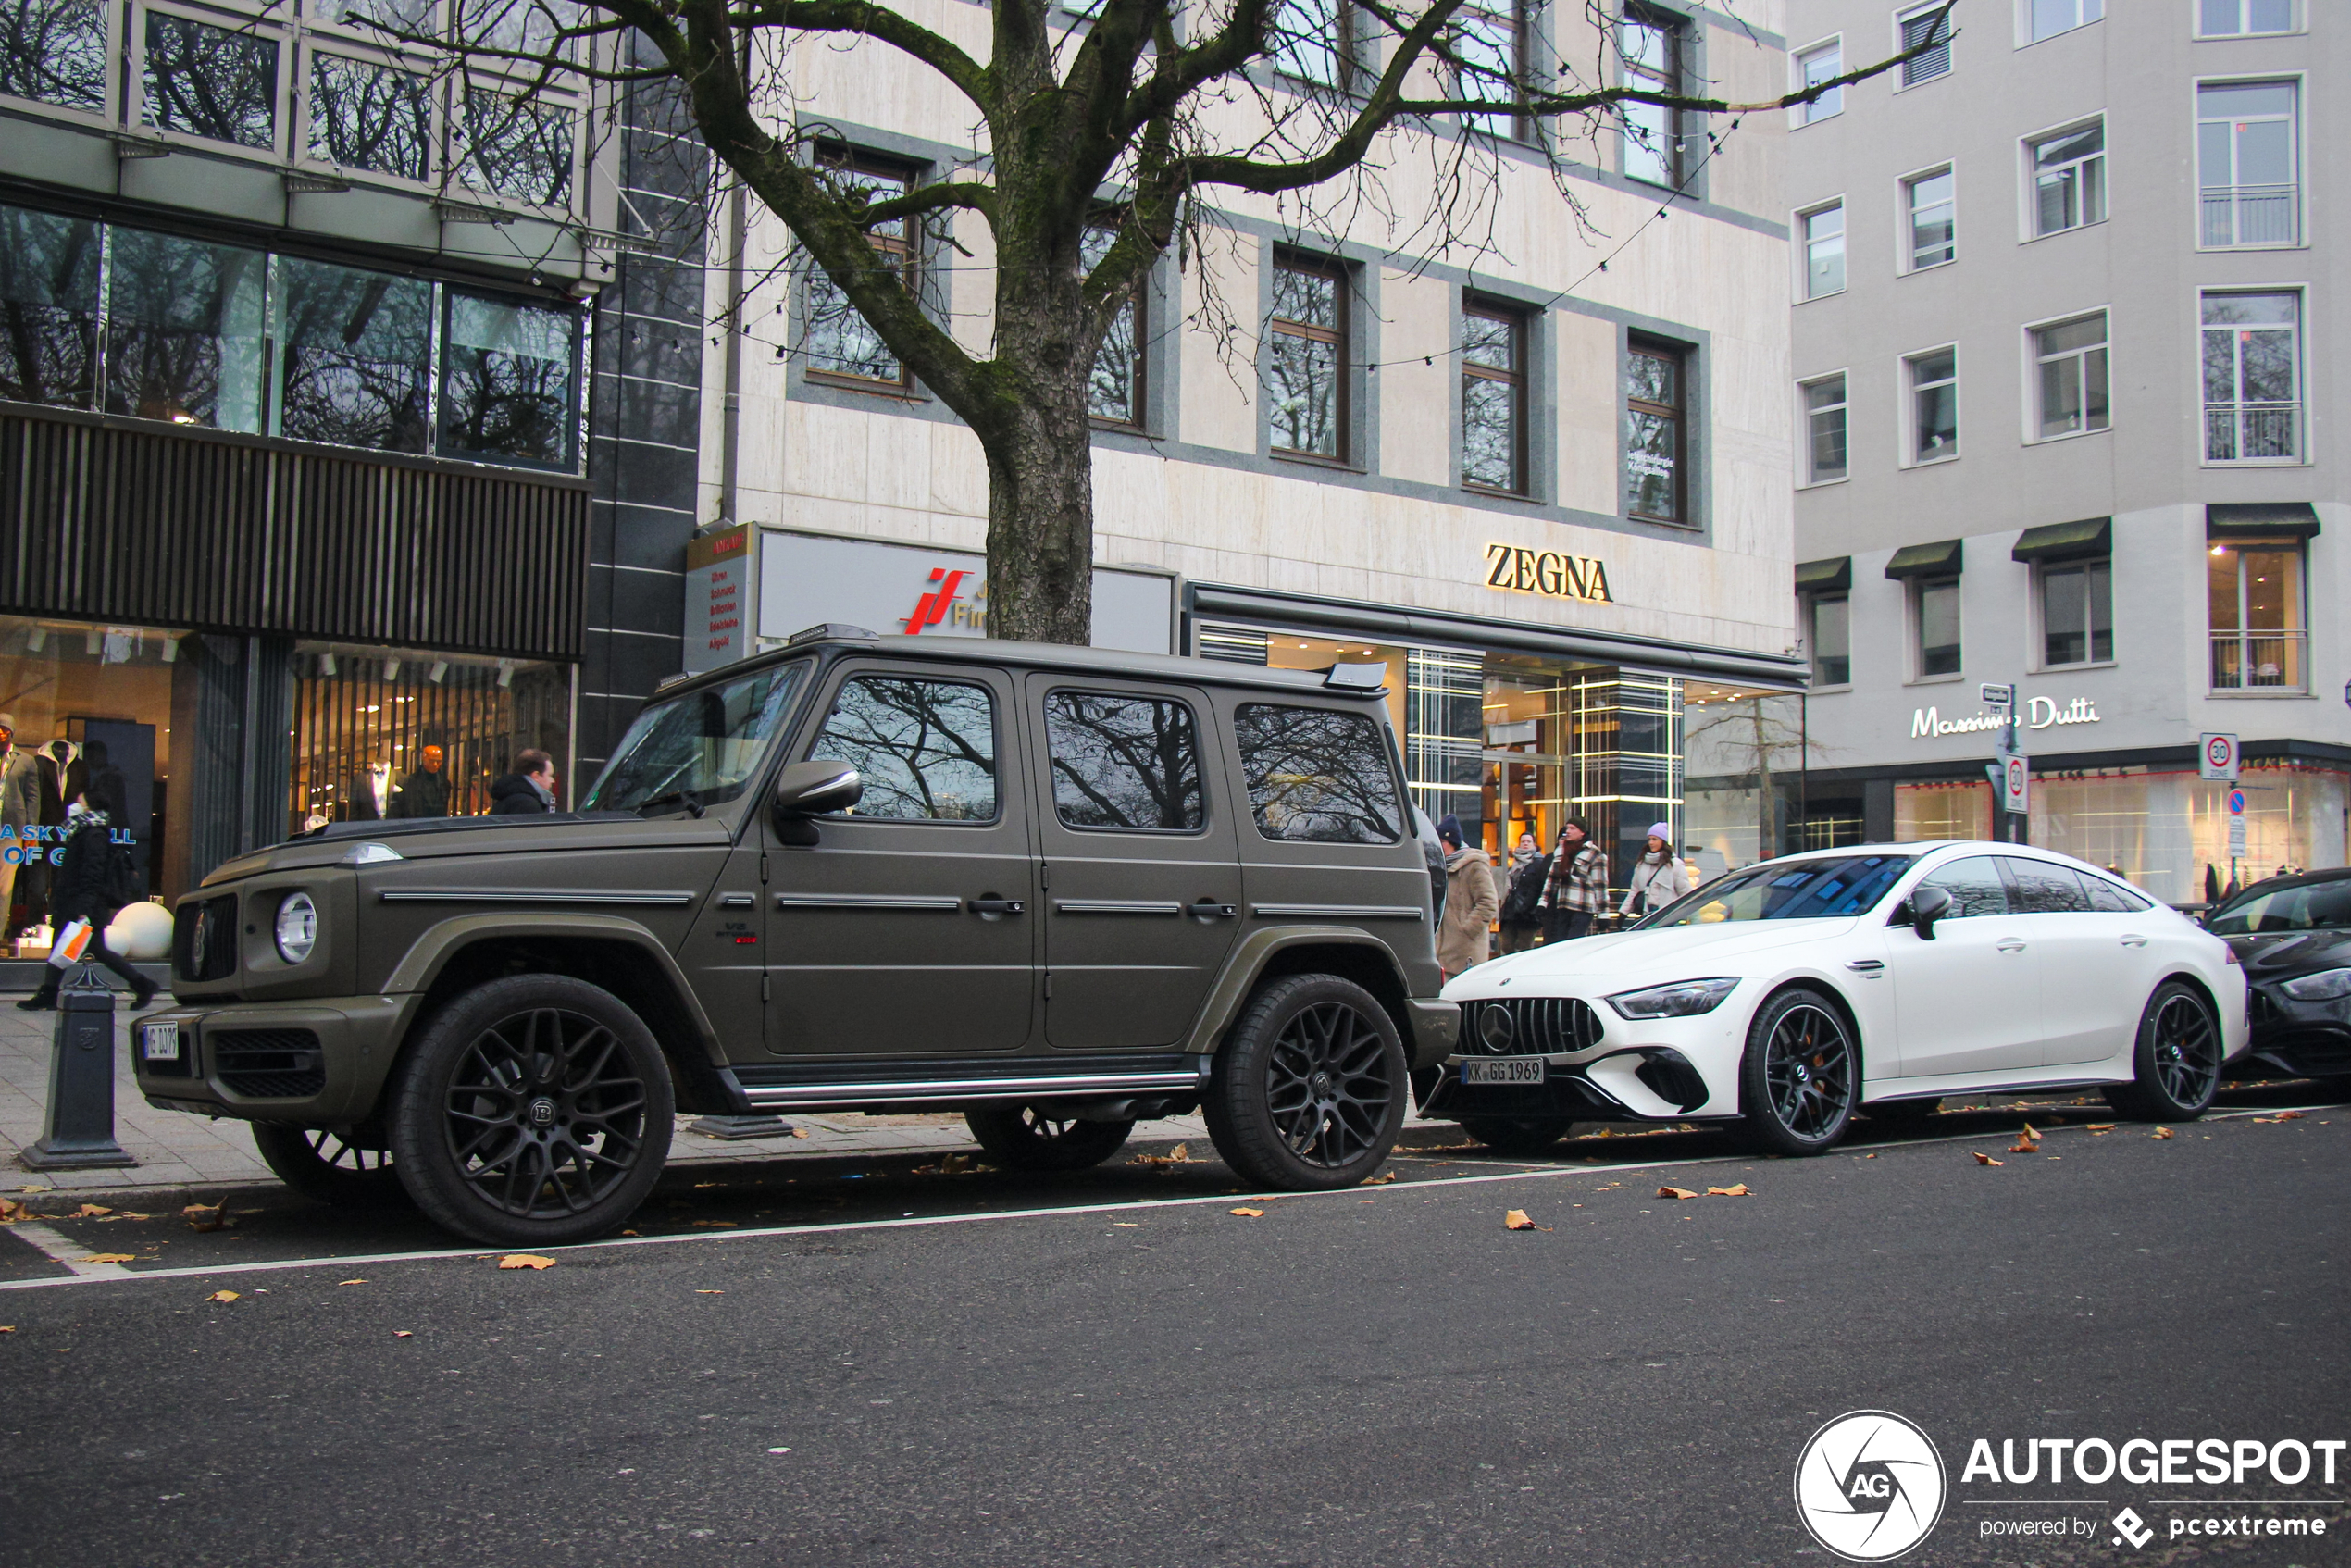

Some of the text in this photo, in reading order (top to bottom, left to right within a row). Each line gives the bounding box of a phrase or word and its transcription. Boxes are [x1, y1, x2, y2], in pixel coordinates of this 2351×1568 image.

[712, 533, 743, 554] ANKAUF
[1486, 544, 1614, 603] ZEGNA
[710, 583, 736, 600] Schmuck
[1910, 696, 2100, 739] Massimo Dutti
[2211, 745, 2227, 759] 30
[2012, 769, 2021, 786] 30
[2210, 769, 2229, 778] ZONE
[0, 824, 17, 840] A
[4, 846, 43, 865] OF
[1468, 1062, 1540, 1081] KK GG 1969
[535, 1105, 552, 1122] B
